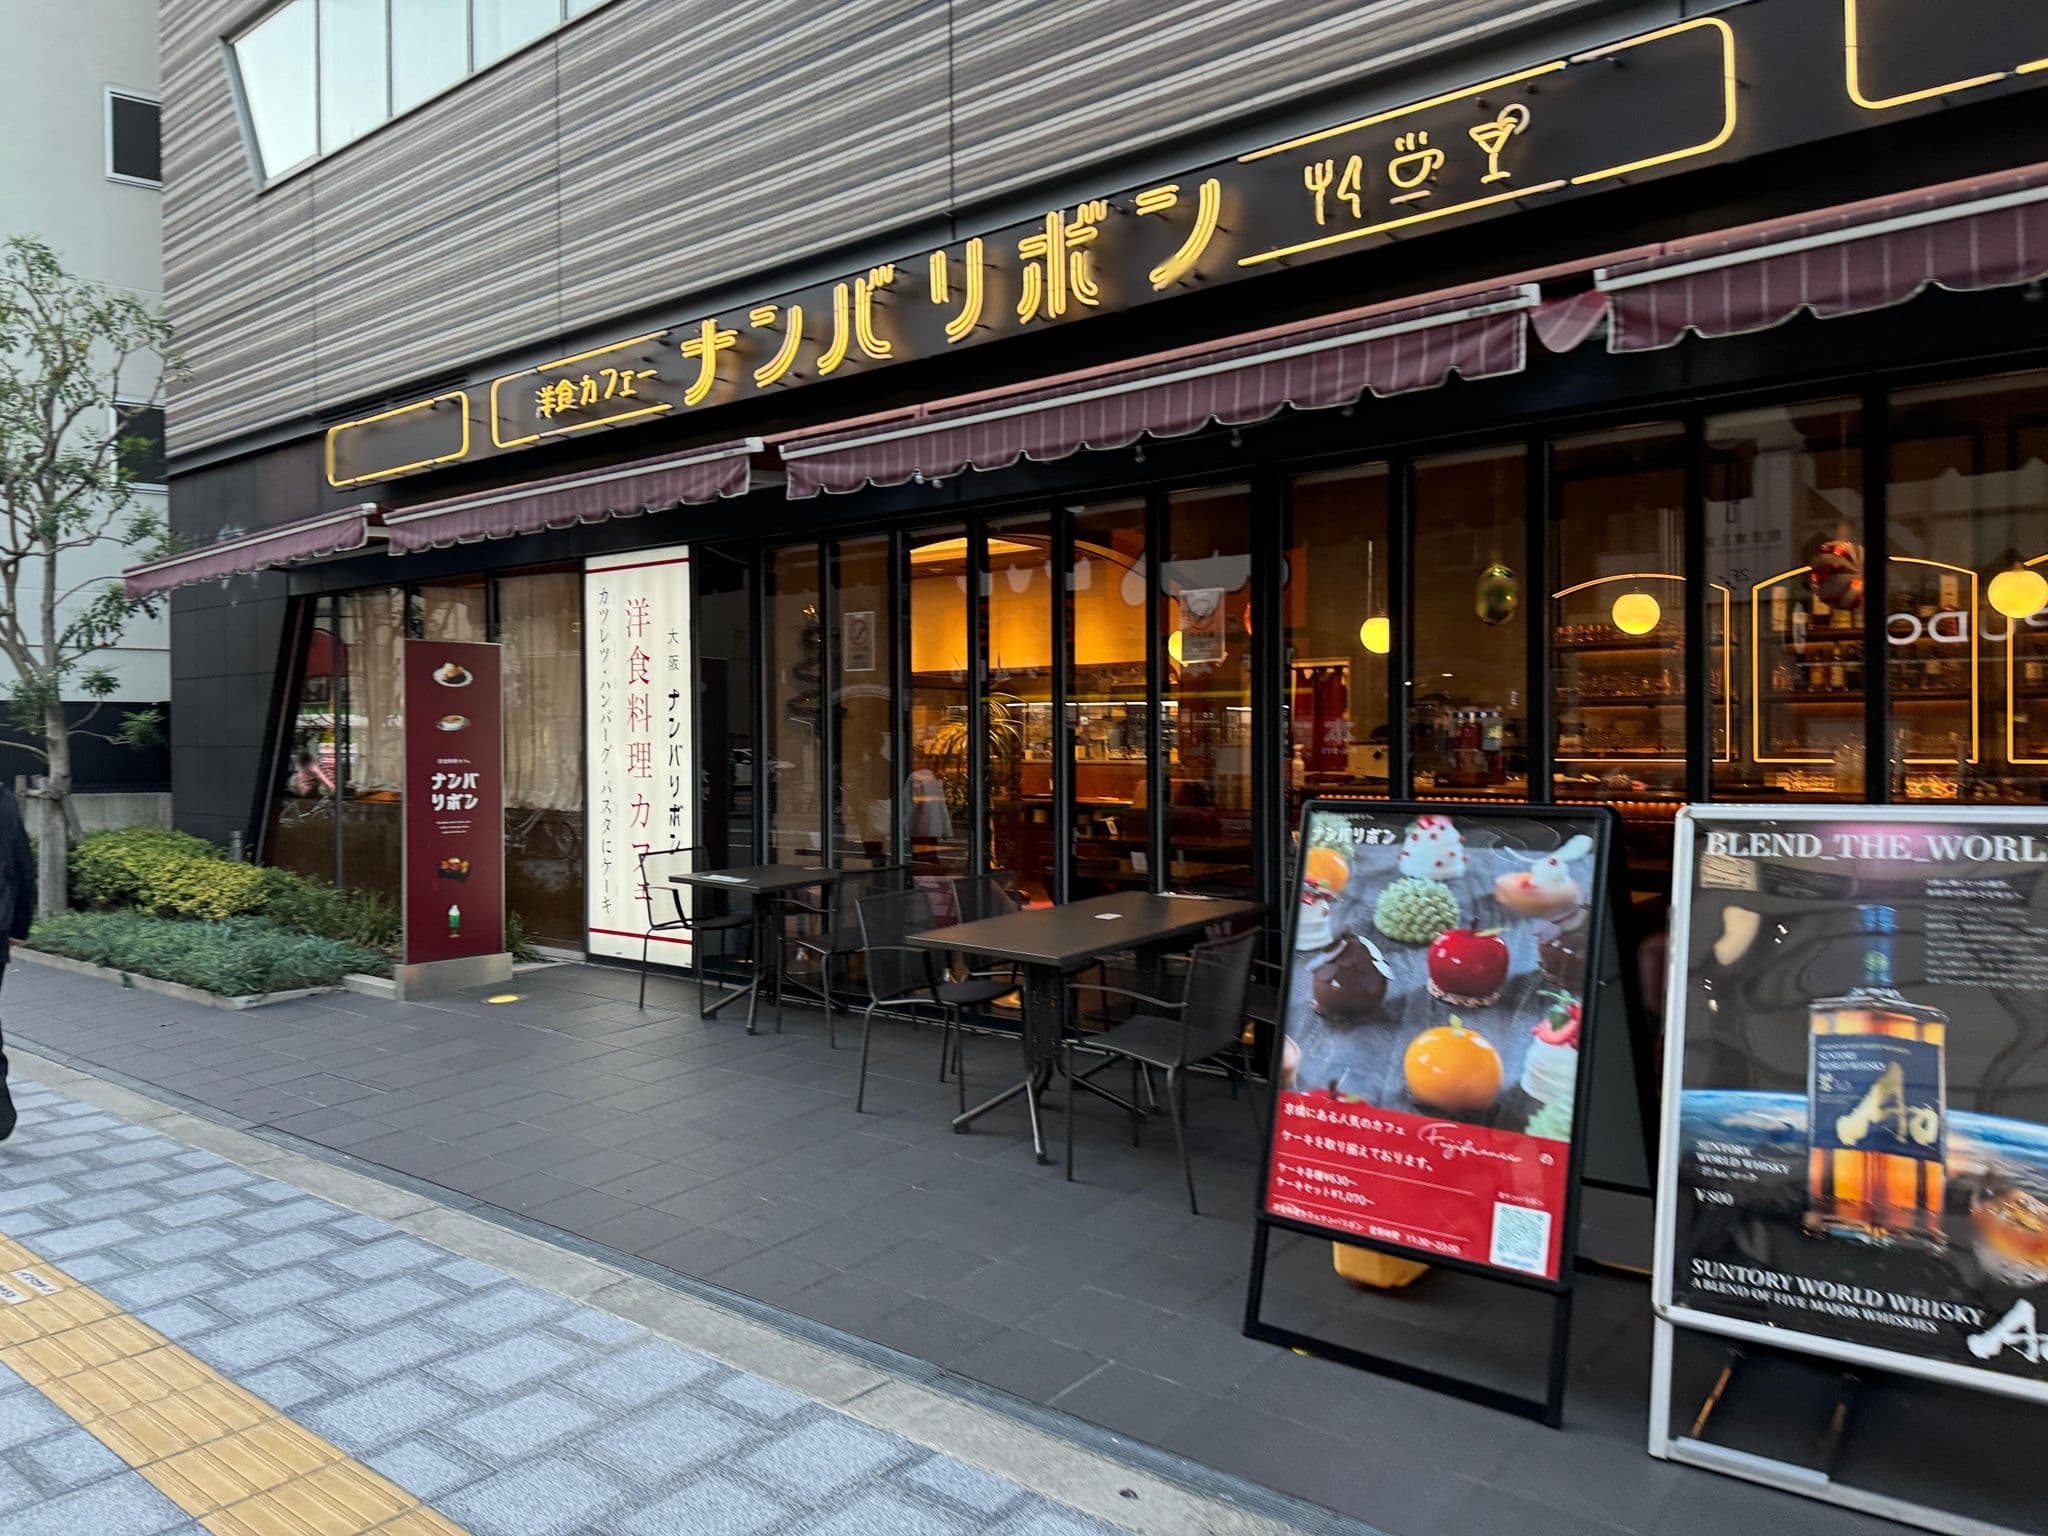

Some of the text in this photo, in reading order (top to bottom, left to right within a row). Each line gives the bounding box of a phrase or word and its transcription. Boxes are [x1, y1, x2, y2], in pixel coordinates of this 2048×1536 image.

[535, 177, 1221, 419] 洋食カフェー ナンバリボン
[431, 772, 480, 790] ナンバ
[431, 793, 479, 811] リボン
[1691, 1257, 1986, 1328] SUNTORY WORLD WHISKY
[1702, 1279, 1750, 1299] BLEND
[1967, 1298, 2048, 1363] A
